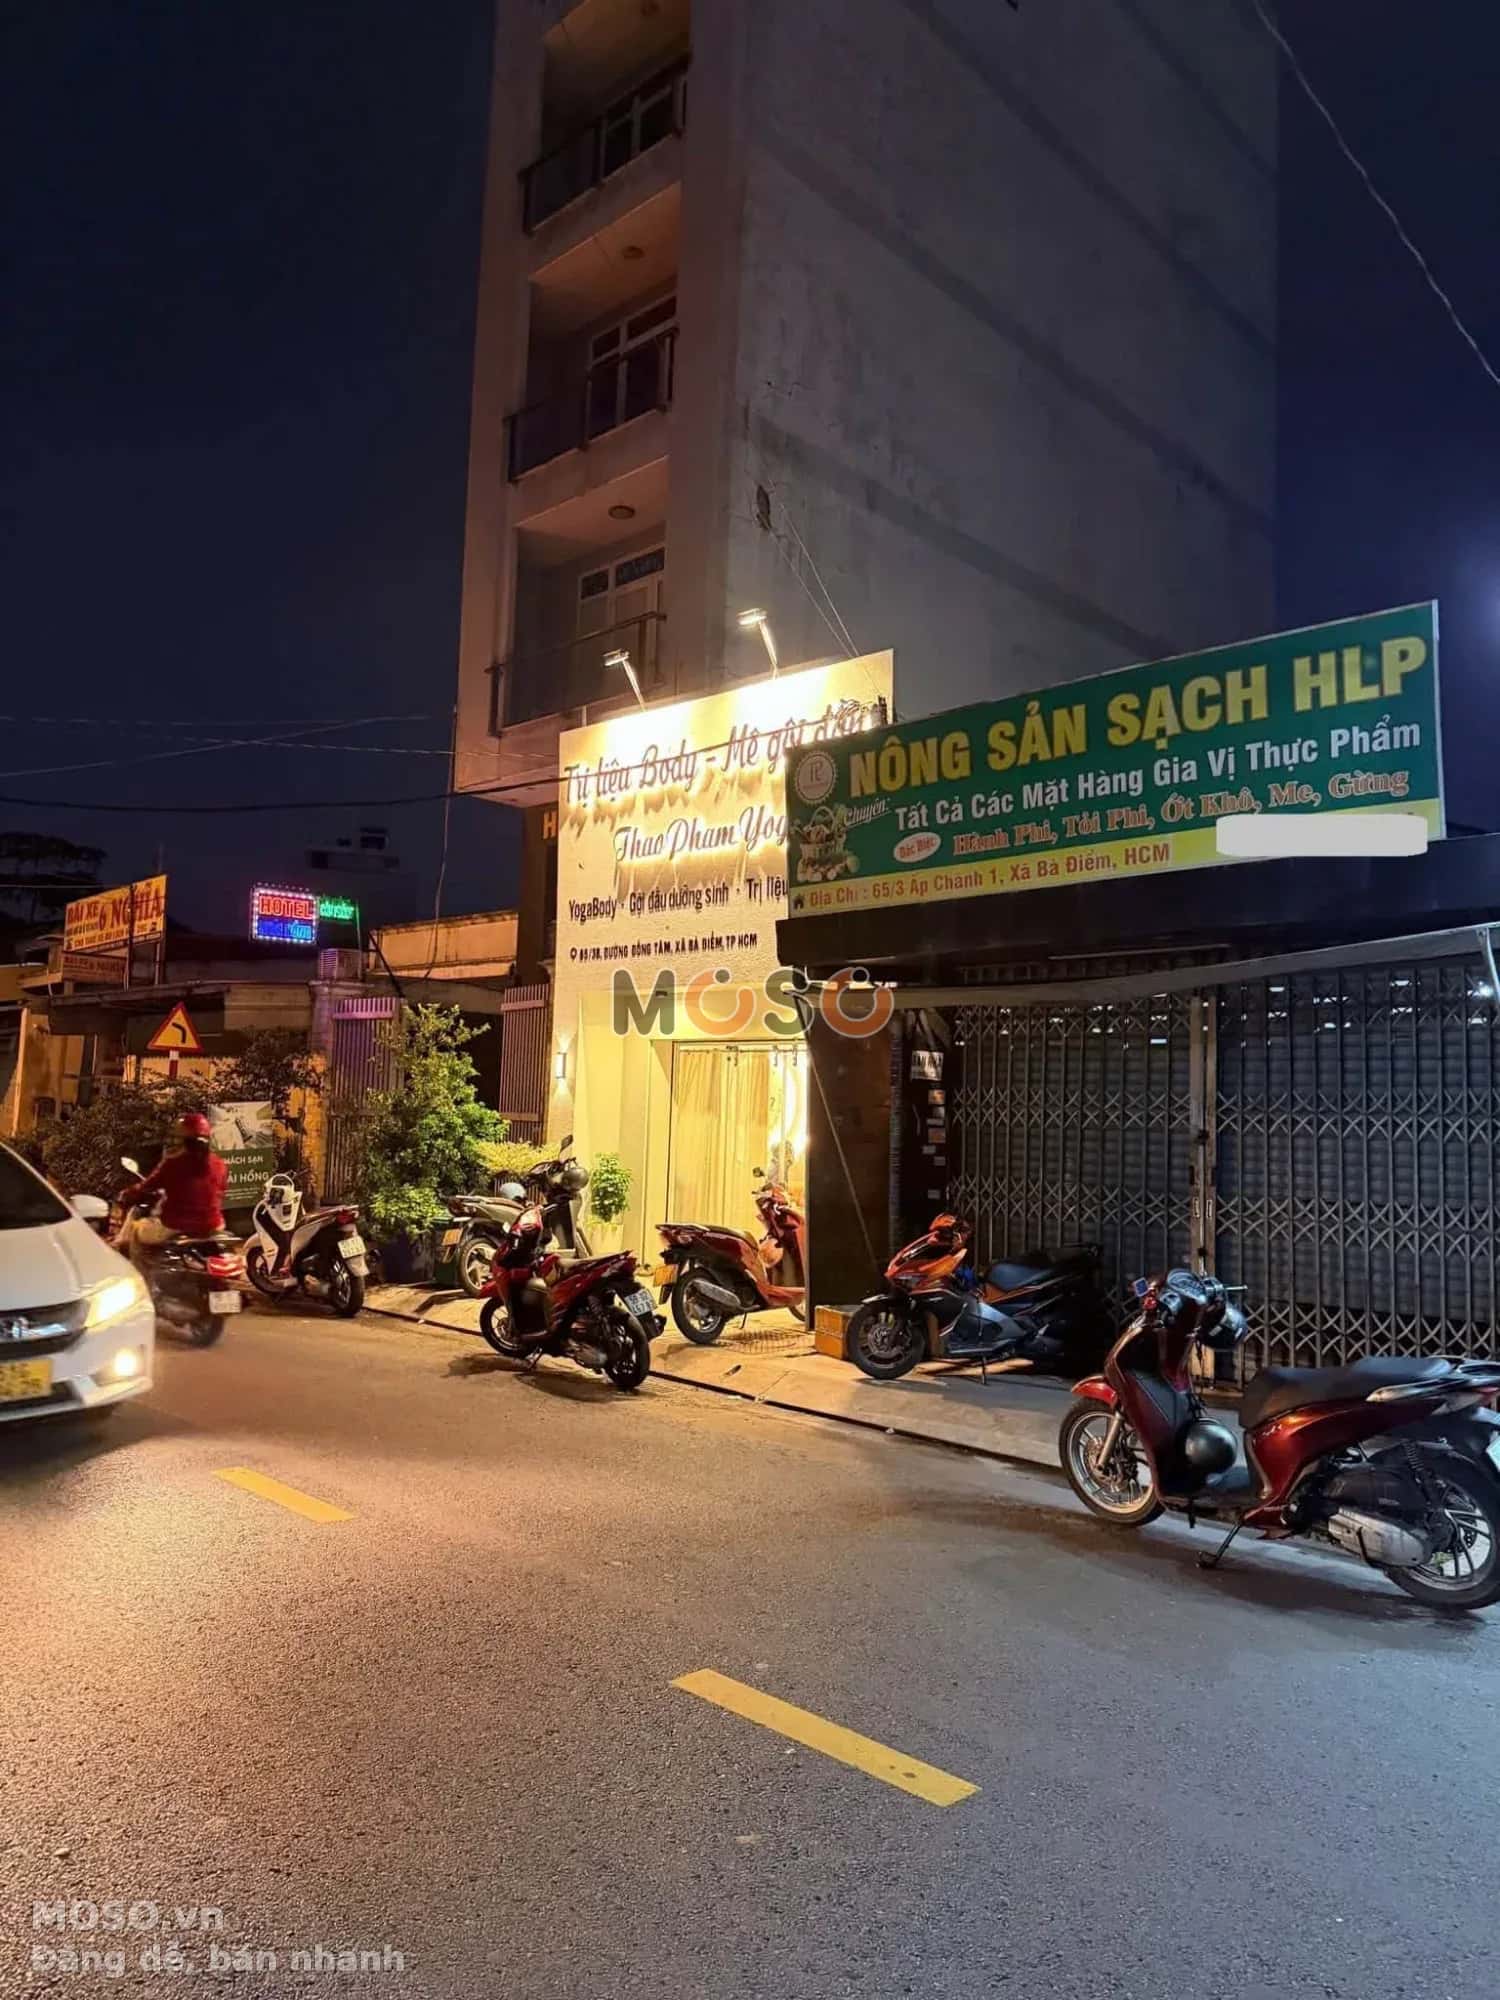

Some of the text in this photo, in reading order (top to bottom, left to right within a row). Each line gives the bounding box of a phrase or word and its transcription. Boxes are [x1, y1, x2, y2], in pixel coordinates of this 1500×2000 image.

[850, 731, 971, 797] NÔNG
[987, 701, 1087, 771] SẢN
[1107, 664, 1269, 749] SẠCH
[1293, 634, 1428, 712] HLP
[639, 739, 697, 792] Body
[896, 801, 928, 831] Tất
[936, 796, 963, 824] Cả
[971, 790, 1014, 819] Các
[1022, 779, 1069, 811] Mặt
[1077, 769, 1144, 800] Hàng
[1153, 755, 1198, 786] Gia
[1208, 747, 1235, 781] Vị
[1246, 738, 1318, 772] Thực
[1330, 714, 1421, 758] Phẩm
[666, 817, 738, 860] Pham
[739, 805, 788, 852] Yog
[952, 829, 1010, 856] Hành
[1063, 810, 1101, 838] Tỏi
[1160, 792, 1194, 823] Ớt
[1199, 786, 1262, 818] Khô,
[1267, 780, 1321, 808] Me,
[1328, 768, 1410, 798] Gừng
[872, 879, 905, 898] 65/3
[1010, 863, 1031, 882] Xã
[1037, 856, 1059, 878] Bà
[1065, 849, 1117, 874] Điểm,
[1124, 843, 1170, 866] HCM
[260, 895, 313, 919] HOTEL
[569, 896, 617, 924] YogaBody
[705, 882, 729, 906] sinh
